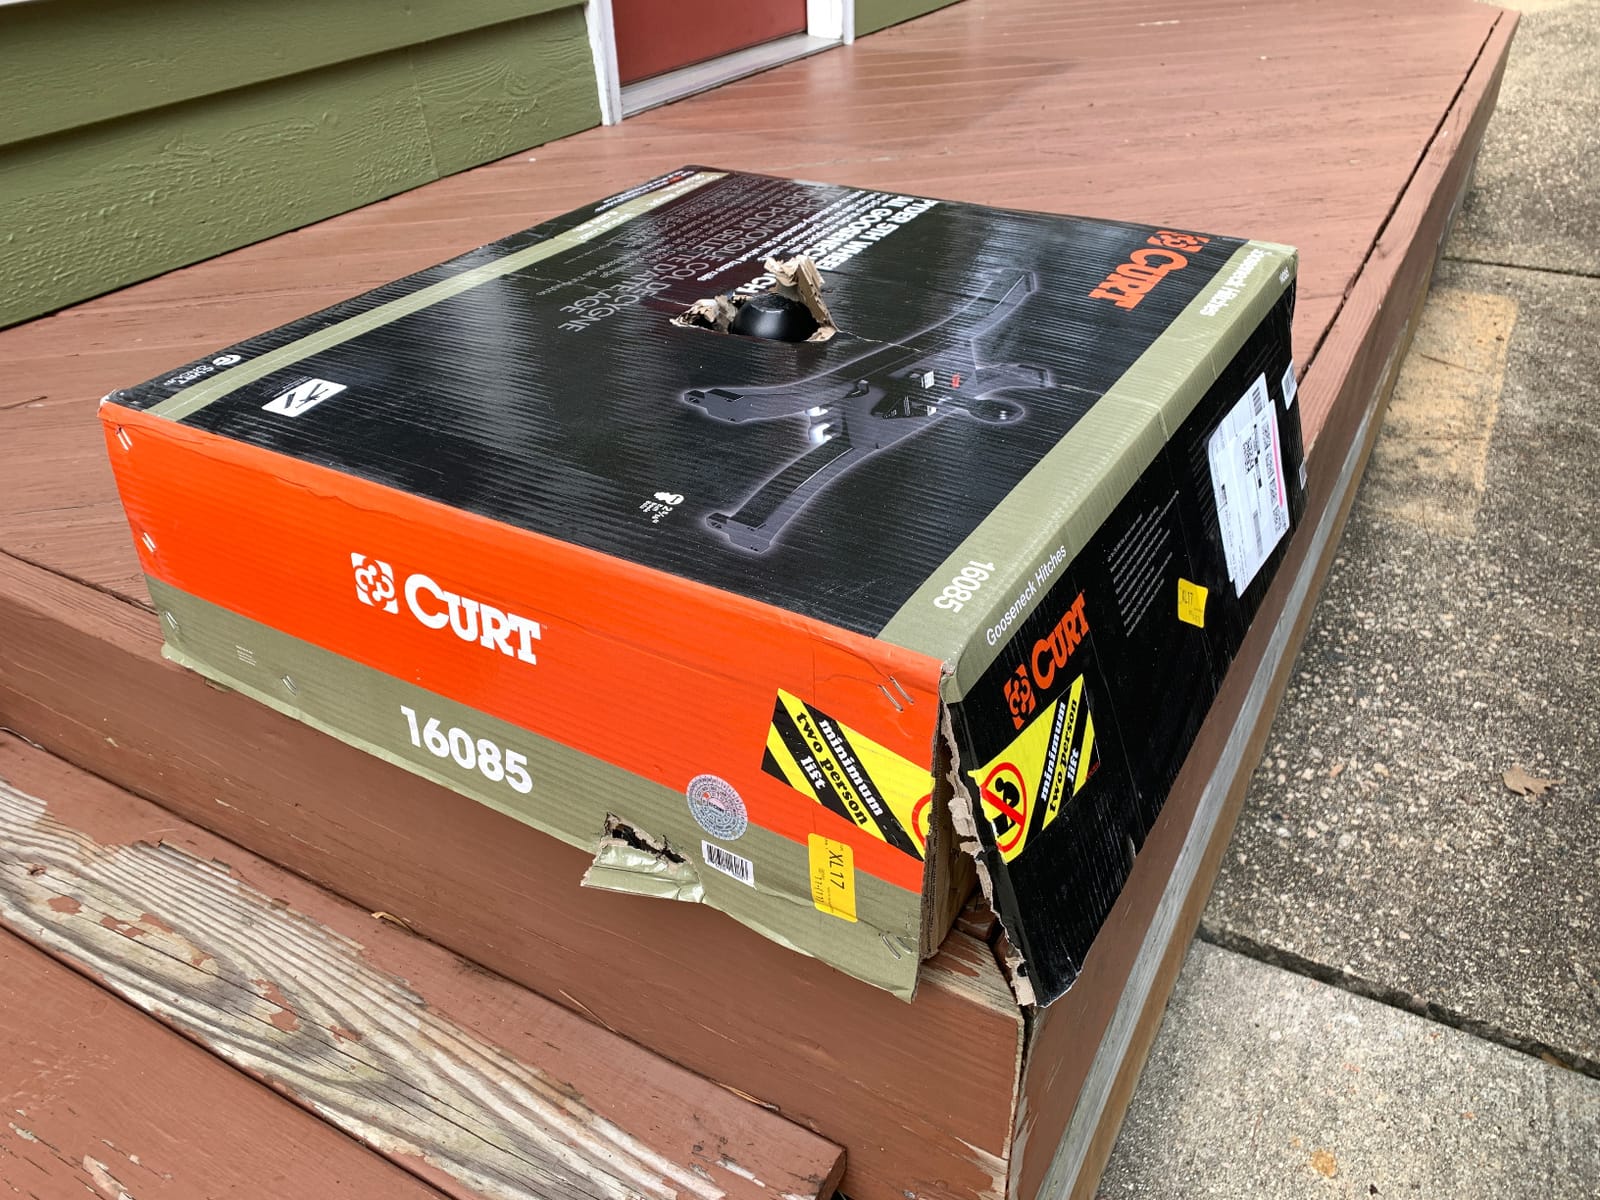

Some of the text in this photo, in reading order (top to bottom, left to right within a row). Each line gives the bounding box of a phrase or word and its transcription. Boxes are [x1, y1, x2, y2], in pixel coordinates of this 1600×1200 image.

[734, 206, 786, 228] POUR
[801, 208, 892, 259] GOOSENEC
[860, 223, 899, 240] 5TH
[896, 199, 940, 224] PYDER
[642, 282, 670, 297] DE
[660, 263, 709, 280] COL
[1088, 248, 1189, 311] CURT
[558, 293, 642, 332] CYGNE
[934, 560, 996, 613] 16085
[986, 545, 1067, 647] Gooseneck Hitches
[404, 573, 541, 665] CURT
[1031, 592, 1089, 690] CURT
[400, 705, 533, 793] 16085
[796, 711, 869, 826] two person
[800, 755, 826, 790] lift
[819, 719, 883, 817] minimum
[1041, 702, 1066, 802] minimum
[1049, 699, 1078, 812] two person
[1067, 748, 1080, 784] lift
[829, 850, 846, 890] XL17
